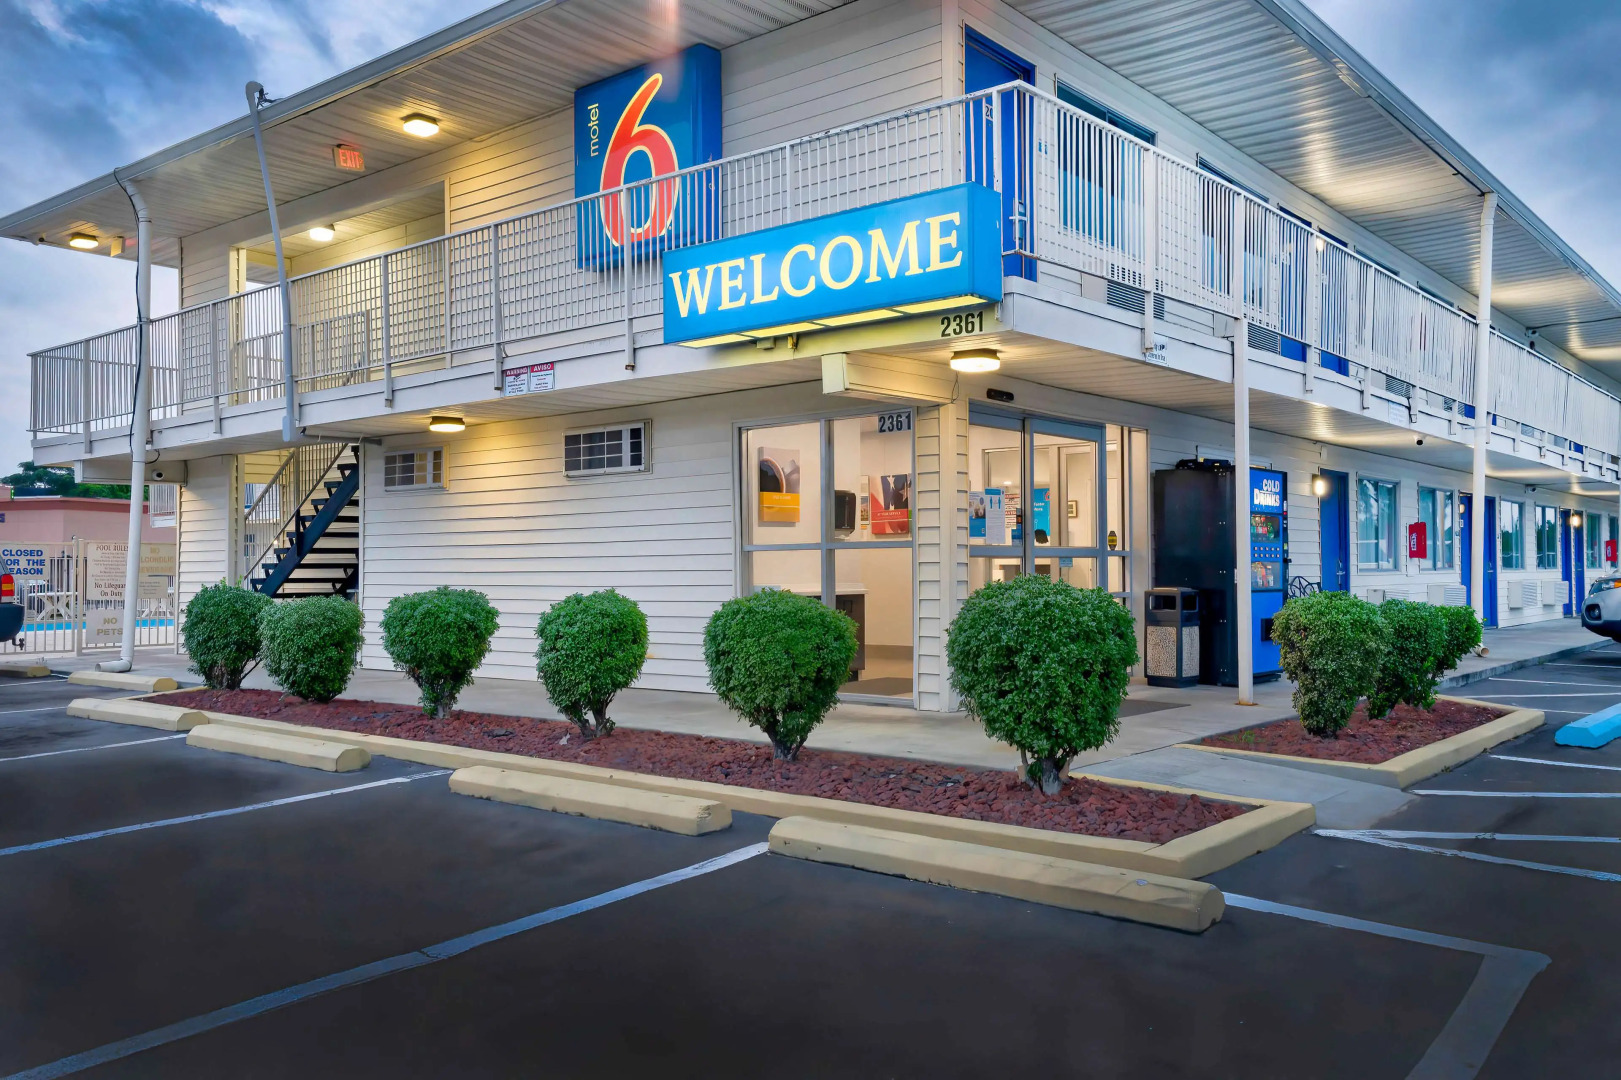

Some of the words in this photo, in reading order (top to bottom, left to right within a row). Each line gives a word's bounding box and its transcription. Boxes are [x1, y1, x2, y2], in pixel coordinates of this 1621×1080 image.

[587, 103, 599, 157] motel
[338, 149, 360, 168] EXIT
[600, 73, 679, 246] 6
[669, 212, 963, 318] WELCOME
[941, 311, 983, 337] 2361
[533, 364, 551, 372] AVISO
[879, 412, 912, 433] 2361
[1263, 479, 1280, 492] COLD
[1253, 488, 1280, 507] DRINKS
[2, 549, 43, 557] CLOSED
[5, 558, 20, 567] OR
[26, 558, 46, 567] THE
[8, 567, 43, 576] EASON
[104, 582, 127, 590] Lifeguar
[110, 590, 123, 598] Duty
[103, 617, 118, 625] NO
[96, 628, 124, 636] PETS
